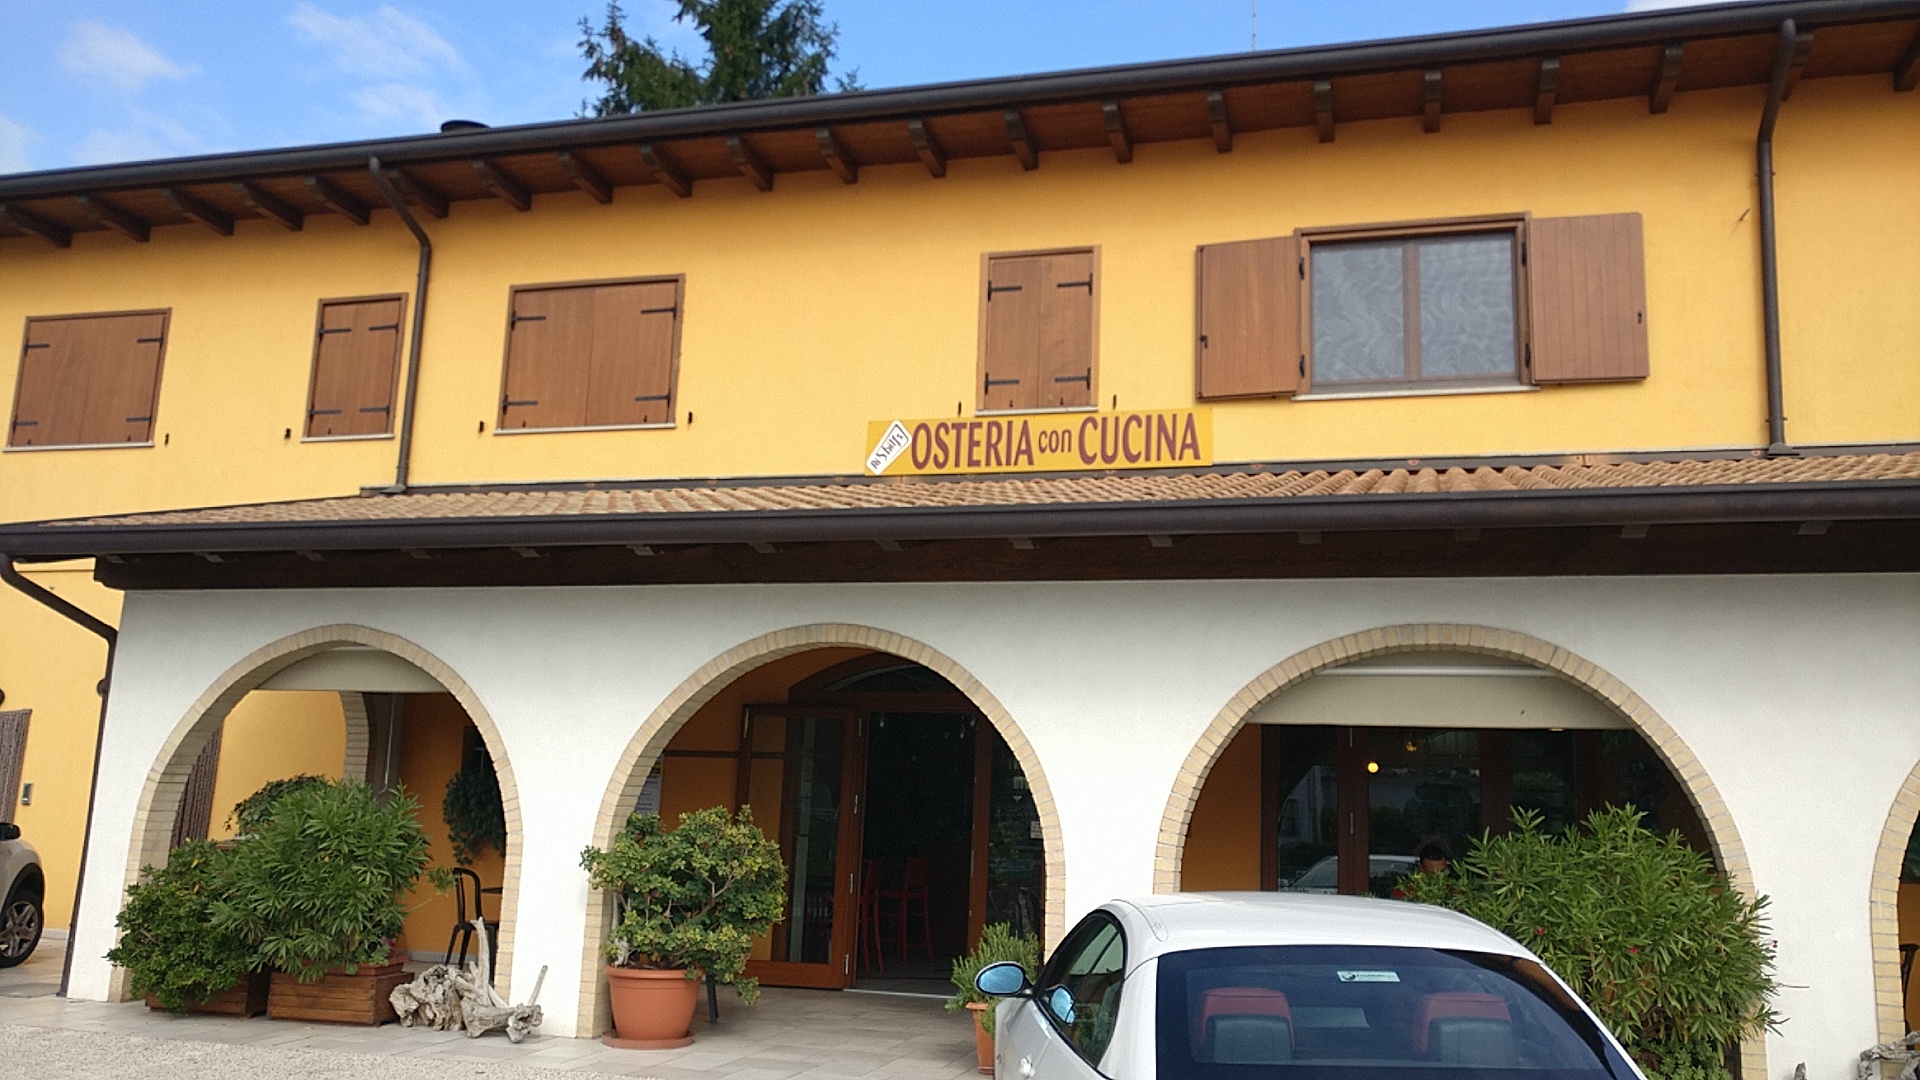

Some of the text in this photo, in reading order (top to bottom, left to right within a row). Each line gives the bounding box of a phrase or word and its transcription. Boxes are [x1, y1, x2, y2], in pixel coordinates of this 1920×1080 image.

[911, 412, 1201, 470] OSTERIA con CUCINA
